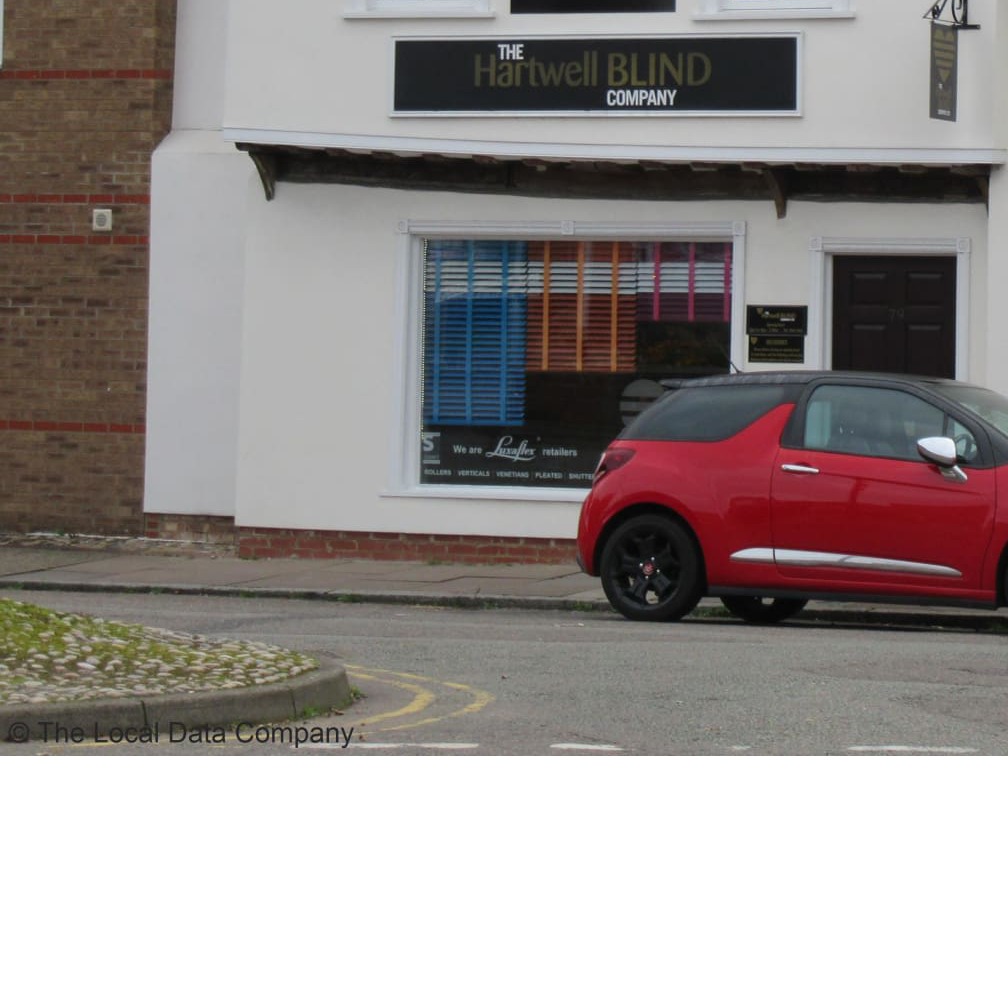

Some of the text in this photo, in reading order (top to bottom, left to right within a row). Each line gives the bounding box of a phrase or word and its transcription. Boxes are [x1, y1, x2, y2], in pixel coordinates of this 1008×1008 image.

[498, 44, 524, 60] THE
[473, 50, 713, 88] Hartwell BLIND
[606, 90, 677, 106] COMPANY
[453, 435, 578, 461] We are Luxaflex retailers
[457, 469, 490, 477] VERTICALS
[496, 470, 530, 479] VENETIANS
